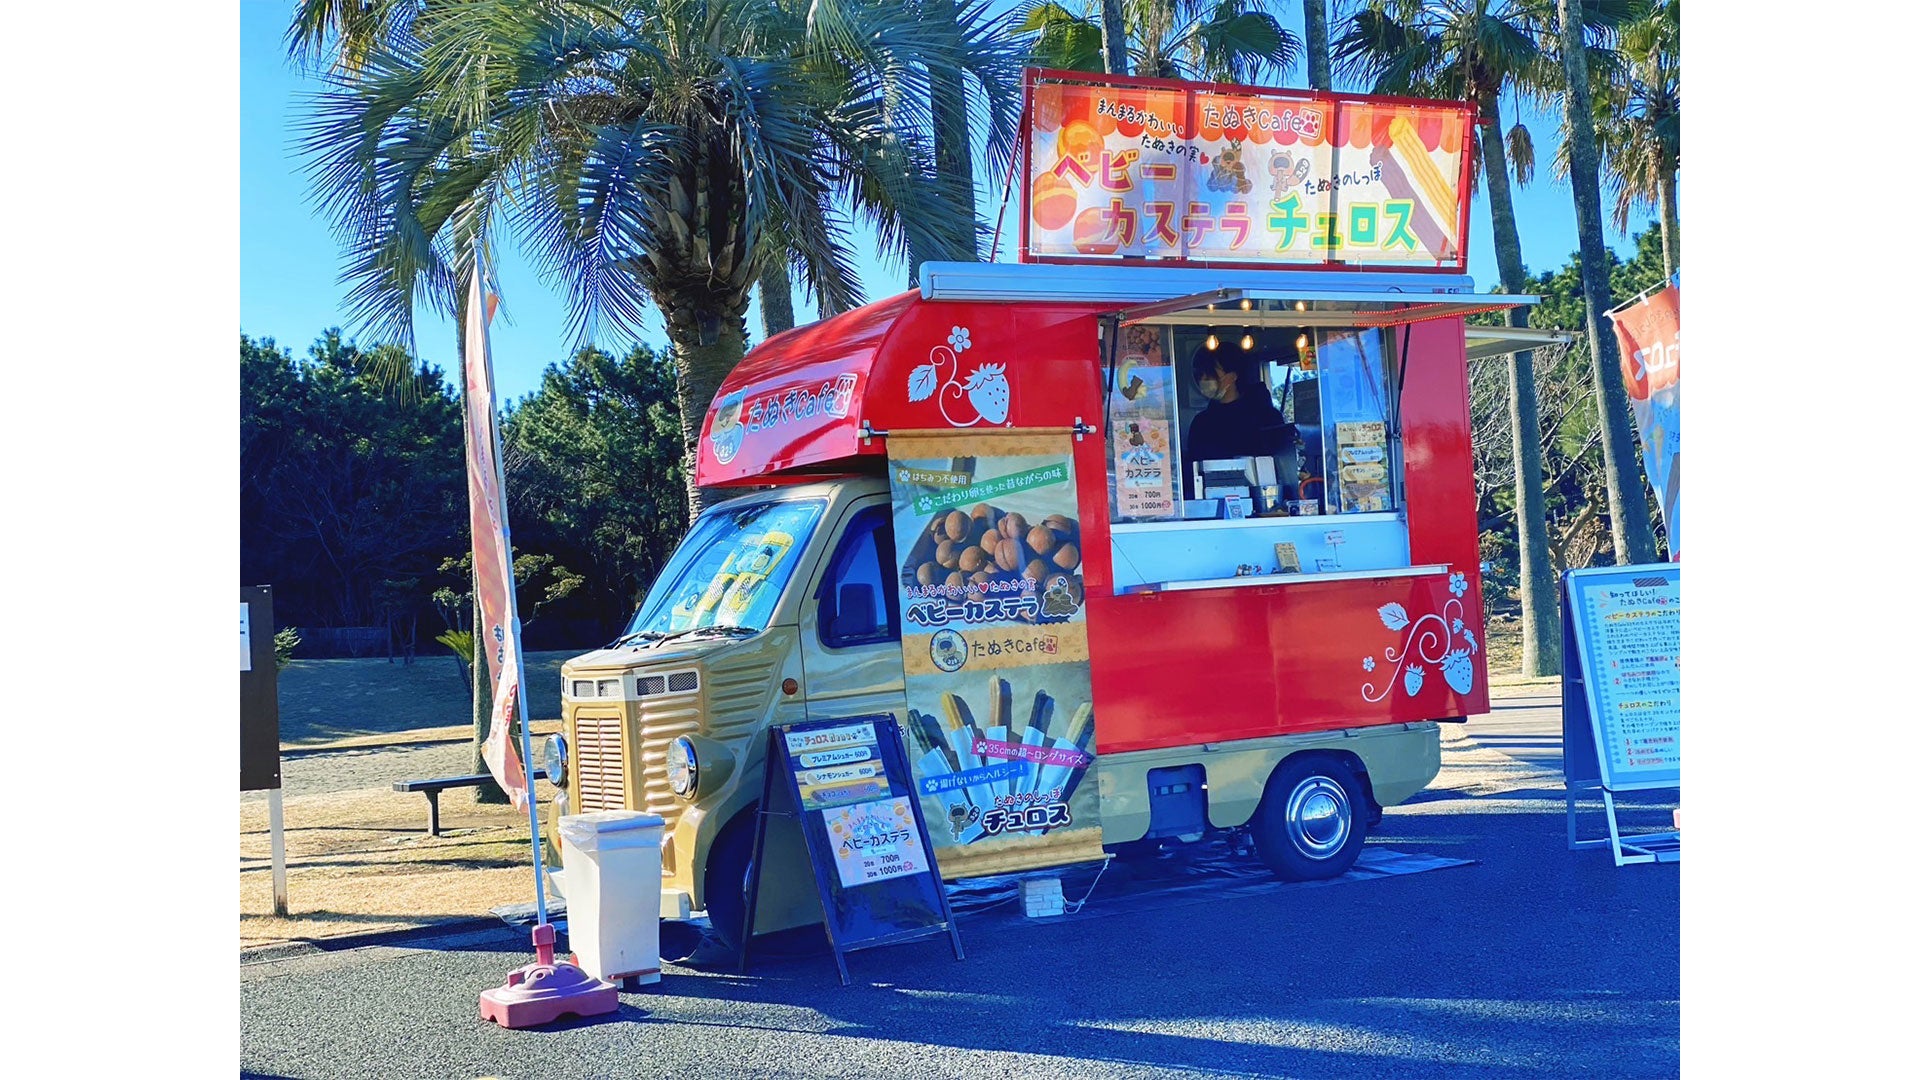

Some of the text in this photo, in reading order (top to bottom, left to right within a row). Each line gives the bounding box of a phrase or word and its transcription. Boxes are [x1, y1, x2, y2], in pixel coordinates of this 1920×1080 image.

[1097, 99, 1184, 134] まんまるかわいい
[1203, 103, 1302, 132] たぬきCafe
[1141, 134, 1200, 162] たぬきの実
[1052, 148, 1177, 194] ベビー
[1304, 162, 1383, 195] たぬきのしっぽ
[1101, 197, 1253, 251] カステラ
[1266, 190, 1420, 253] チュロス
[745, 382, 838, 434] たぬきCafe
[912, 473, 967, 485] はちみつ不使用
[934, 468, 1063, 507] こだわり卵を使った昔ながらの味
[1125, 468, 1162, 479] カステラ
[906, 596, 1040, 625] ベビーカステラ
[971, 637, 1046, 658] たぬきCafe
[811, 752, 854, 763] プレミアムシュガー
[816, 771, 854, 780] シナモンシュガー
[994, 785, 1064, 806] たぬきのしっぽ
[982, 802, 1071, 834] チュロス
[879, 865, 904, 876] 1000円
[881, 854, 900, 864] 700円
